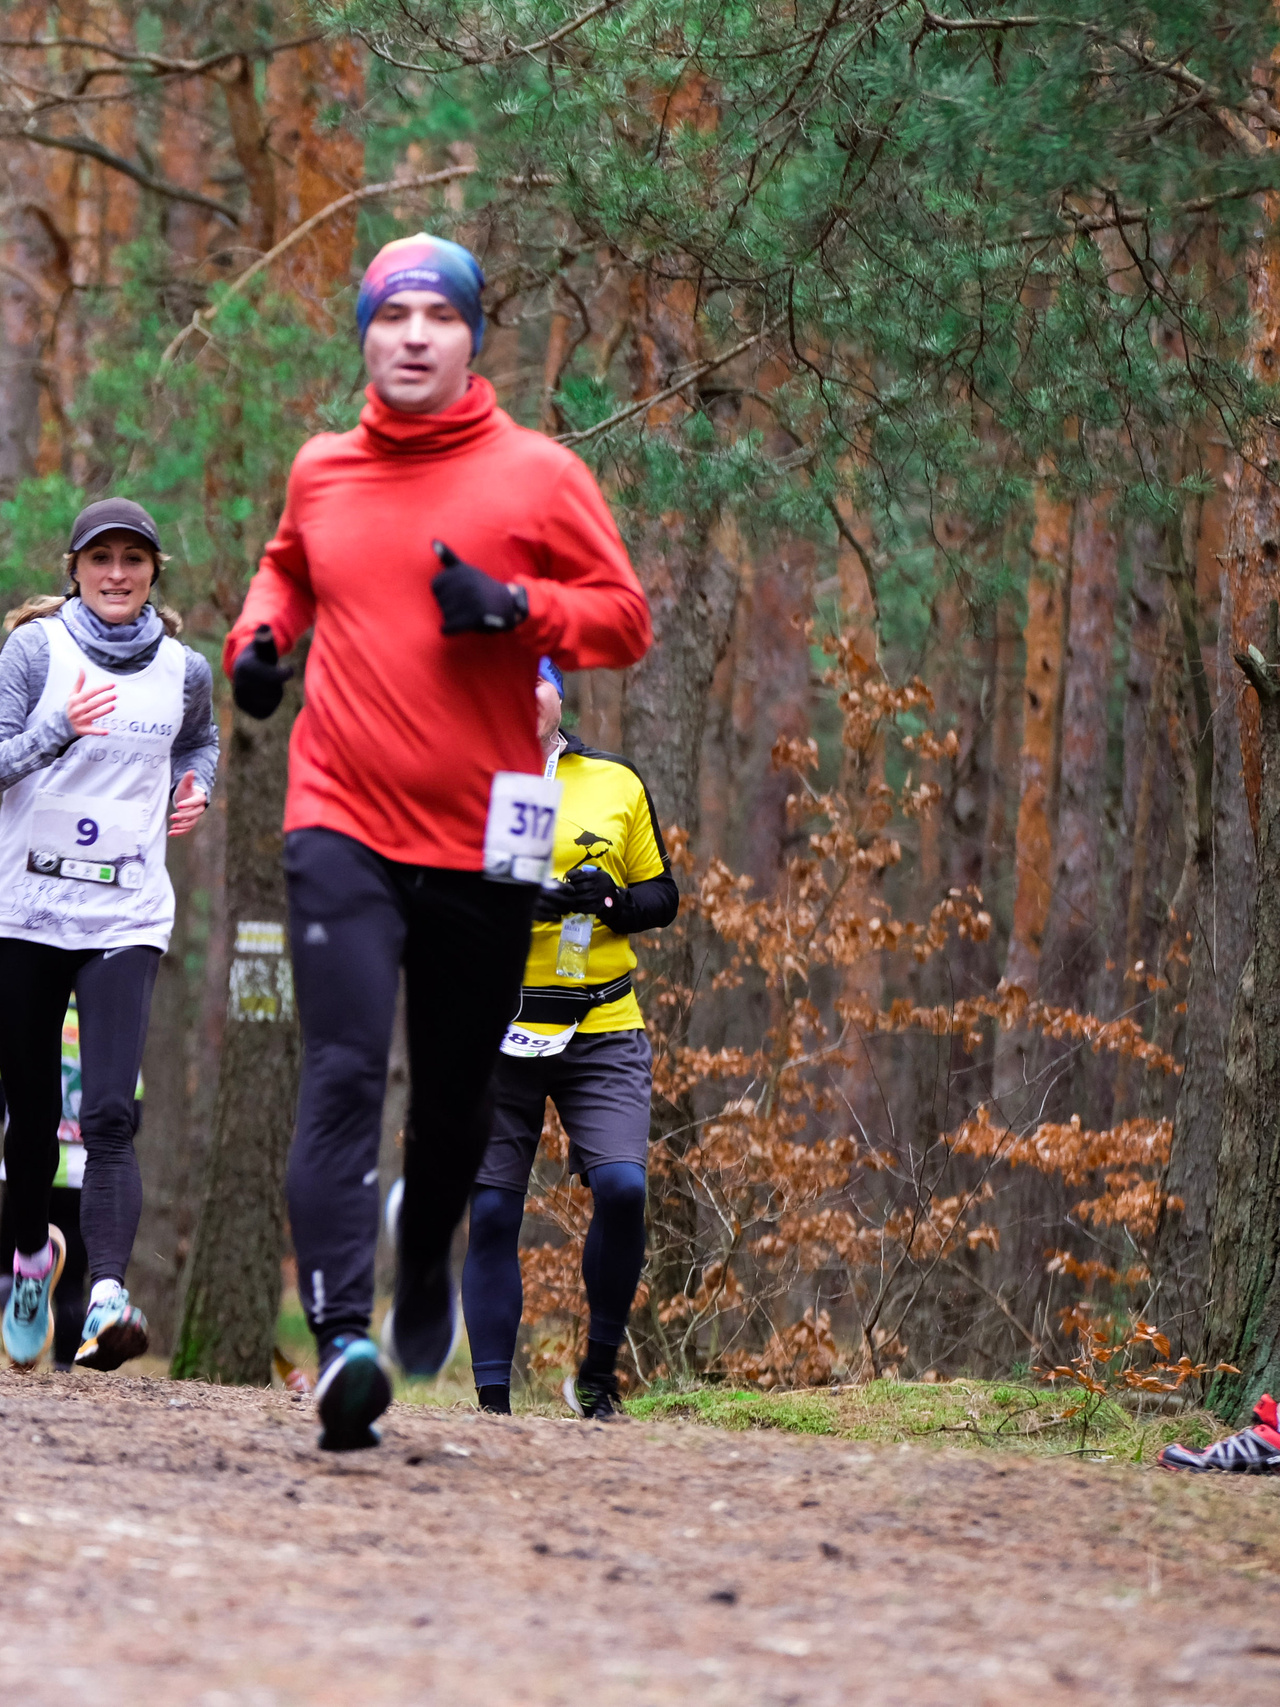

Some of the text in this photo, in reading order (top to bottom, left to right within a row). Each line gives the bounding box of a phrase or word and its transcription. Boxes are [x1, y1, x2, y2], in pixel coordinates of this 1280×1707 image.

[111, 749, 167, 769] SUPPO
[75, 817, 99, 847] 9
[509, 801, 555, 840] 317
[506, 1032, 551, 1048] 89
